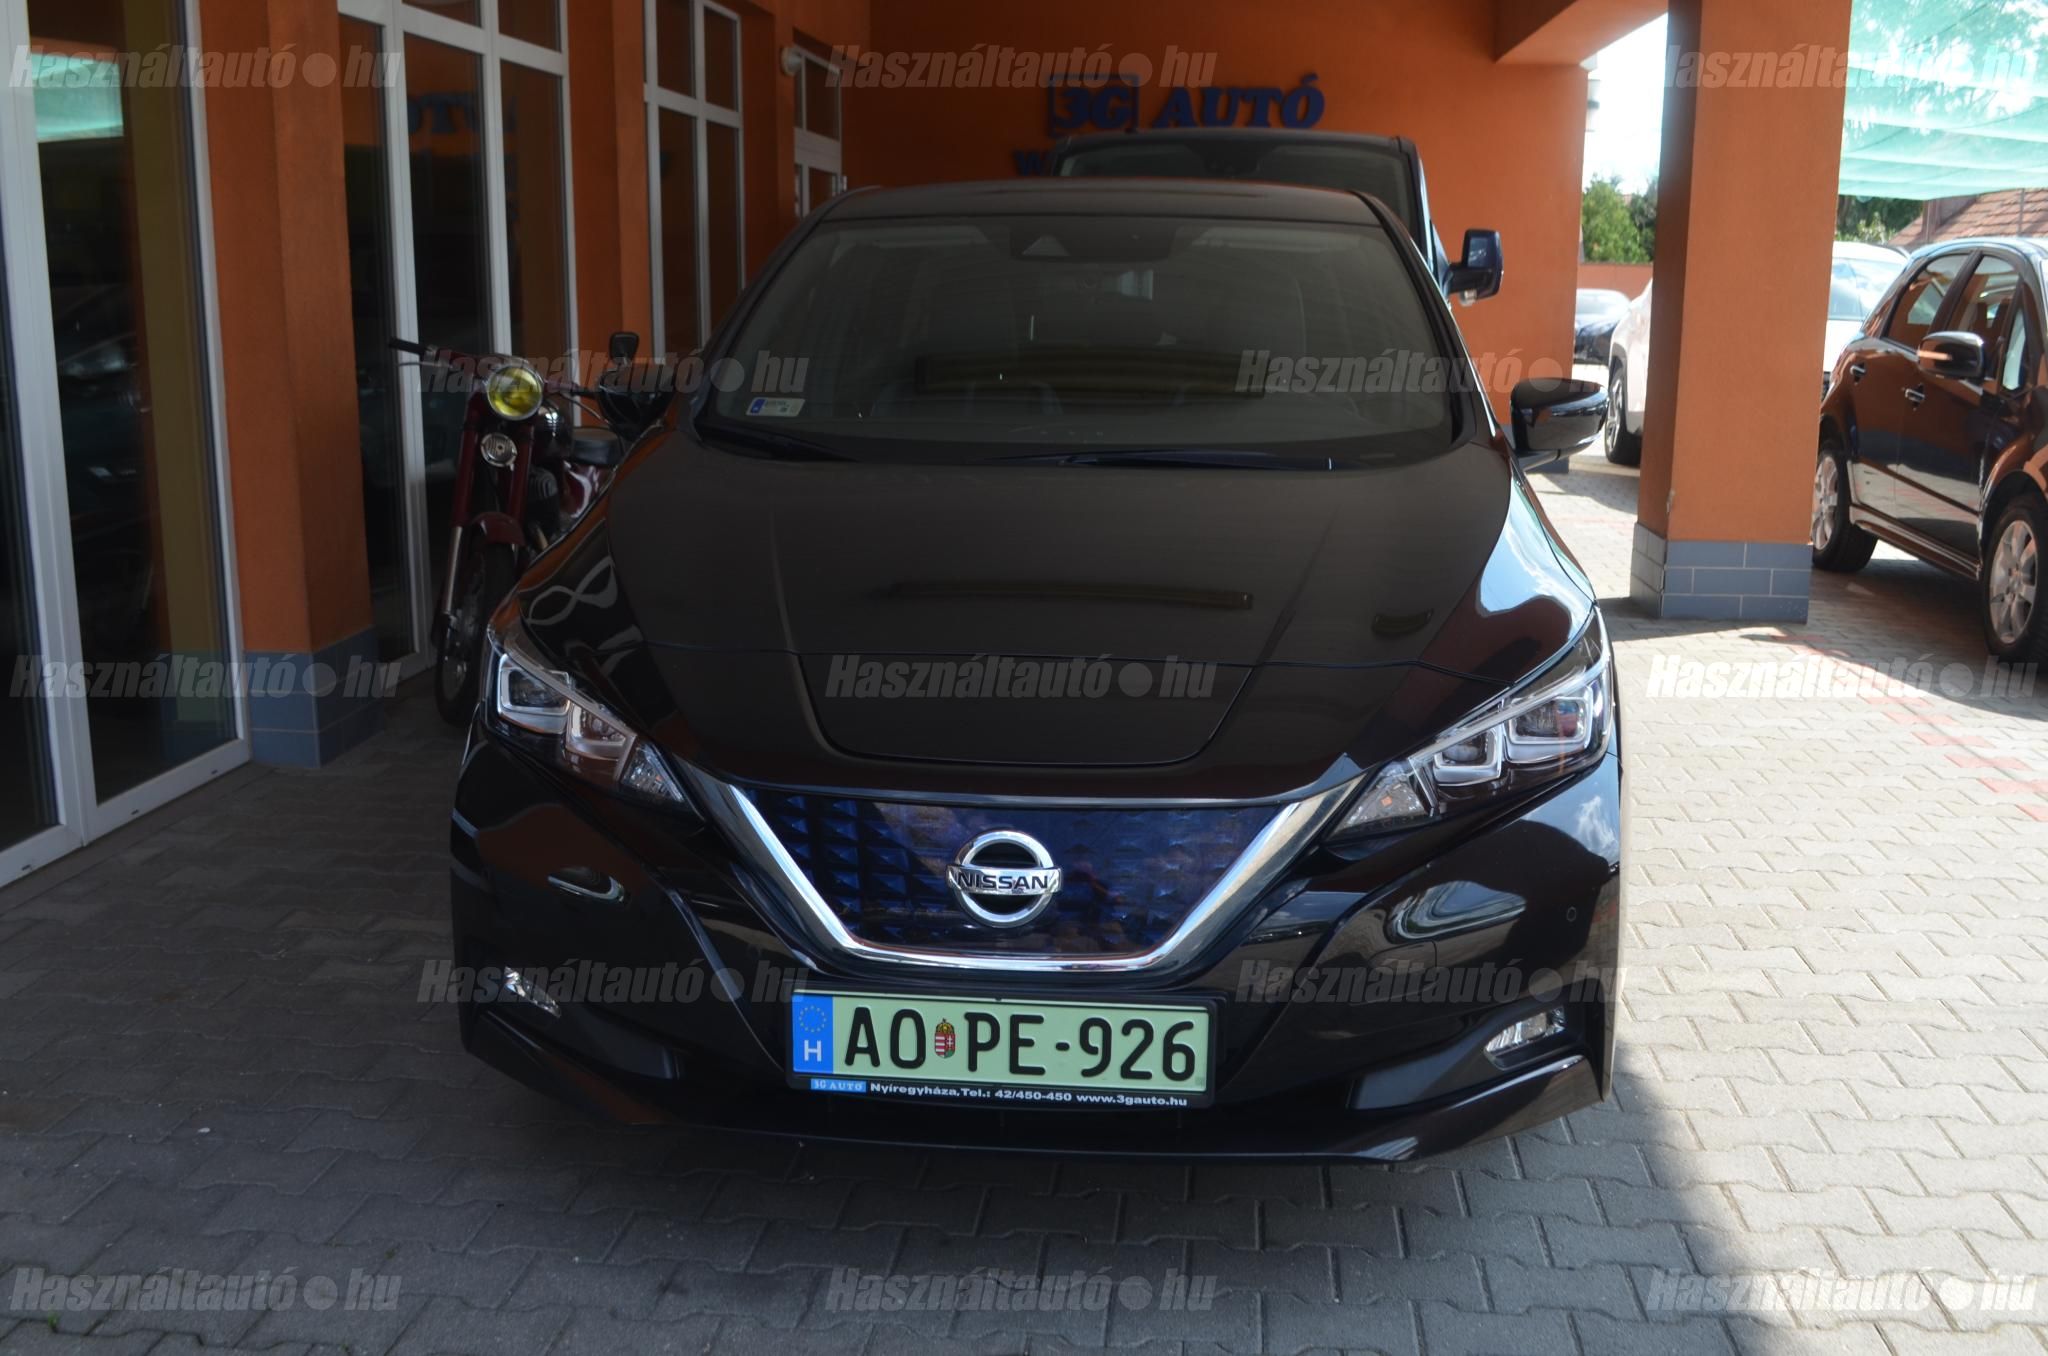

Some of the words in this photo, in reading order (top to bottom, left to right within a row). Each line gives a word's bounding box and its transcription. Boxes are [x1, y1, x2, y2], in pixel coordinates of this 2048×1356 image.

[1055, 86, 1130, 129] 3G
[1151, 72, 1326, 129] AUTÓ
[957, 871, 1048, 890] NISSAN
[803, 1039, 822, 1063] H
[964, 1011, 1196, 1081] PE-926
[994, 1089, 1072, 1102] 42/450-450
[1076, 1093, 1188, 1106] www.3gauto.hu
